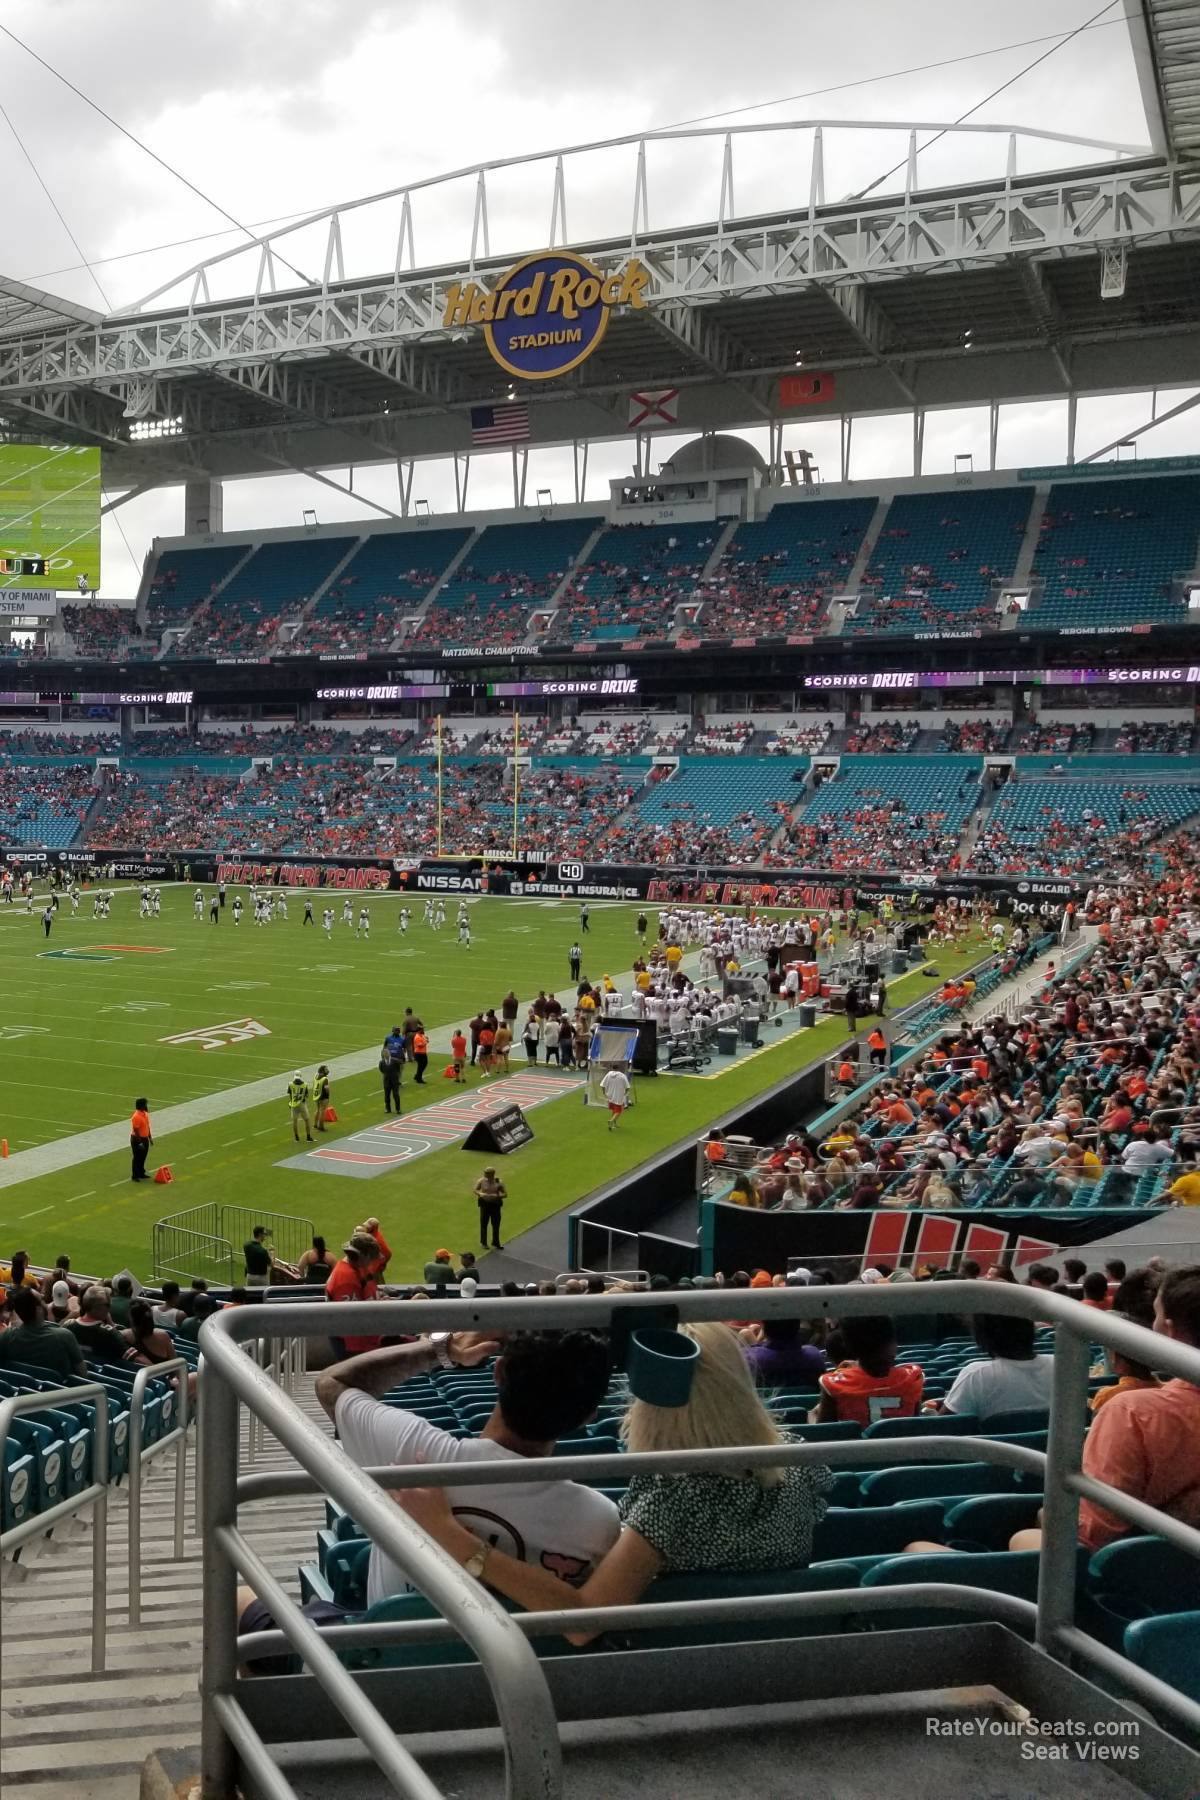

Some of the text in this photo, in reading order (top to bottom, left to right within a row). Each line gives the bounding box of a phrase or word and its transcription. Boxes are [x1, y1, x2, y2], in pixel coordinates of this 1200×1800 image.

[442, 259, 648, 327] Hard Rock
[509, 328, 582, 350] STADIUM
[32, 563, 38, 573] 7
[9, 591, 20, 601] OF
[22, 592, 50, 602] MIAMI
[914, 632, 940, 640] STEVE
[941, 631, 973, 639] WALSH
[1097, 626, 1133, 634] BROWN
[442, 645, 539, 657] NATIONAL CHAMPIONS
[805, 673, 914, 687] SCORING DRIVE
[1108, 670, 1182, 681] SCORING
[316, 686, 399, 699] SCORING DRIVE
[543, 680, 638, 694] SCORING DRIVE
[119, 691, 194, 704] SCORING DRIVE
[6, 852, 48, 862] GEICO
[526, 850, 554, 864] MILK
[114, 864, 135, 873] CKET
[562, 866, 581, 883] 40
[1031, 884, 1071, 894] BACARD
